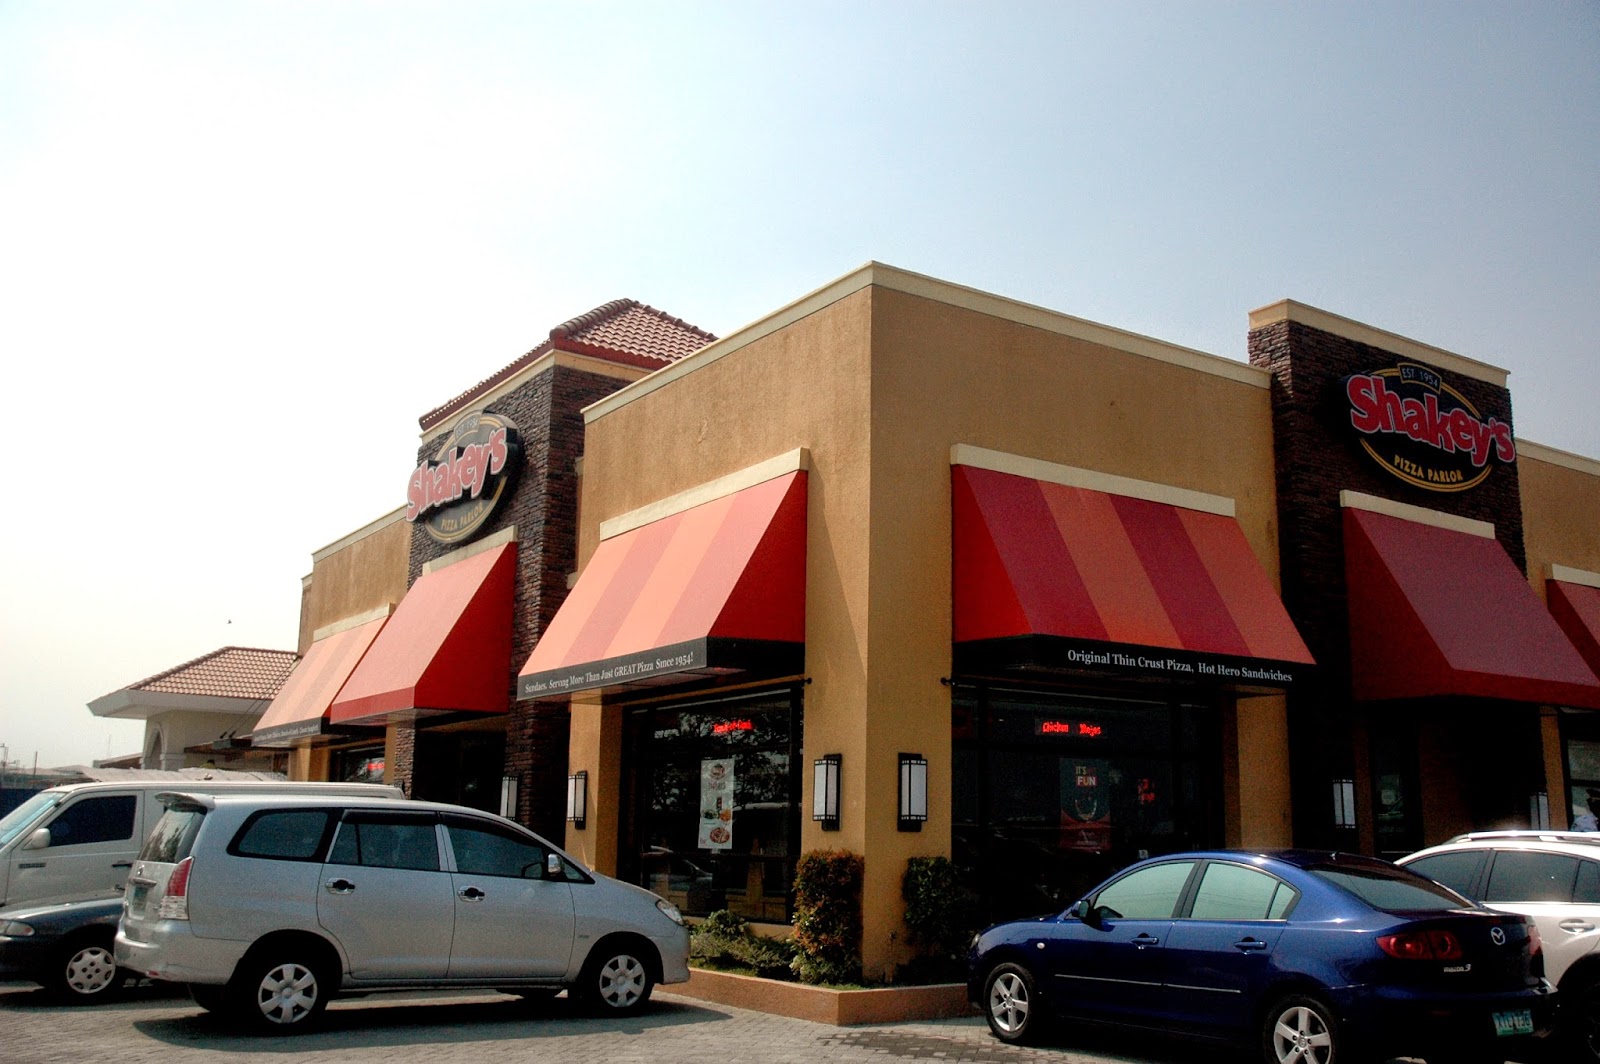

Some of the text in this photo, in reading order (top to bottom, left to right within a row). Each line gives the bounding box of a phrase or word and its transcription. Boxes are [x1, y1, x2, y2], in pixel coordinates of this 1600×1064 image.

[1402, 368, 1438, 387] EST 1954
[1347, 374, 1515, 467] Shakey's
[406, 427, 507, 522] Shakey's
[1394, 454, 1463, 482] PIZZA PARLOR
[441, 518, 458, 531] PIZZA
[549, 679, 570, 689] Serving
[570, 675, 585, 686] More
[586, 671, 600, 683] Than
[601, 669, 614, 680] Just
[614, 664, 637, 677] GREAT
[637, 661, 654, 673] Pizza
[656, 657, 674, 669] Since
[675, 651, 694, 667] 1954!
[1067, 649, 1293, 682] Original Thin Crust Pizza, Hot Hero Sandwiches
[1077, 776, 1096, 786] FUN
